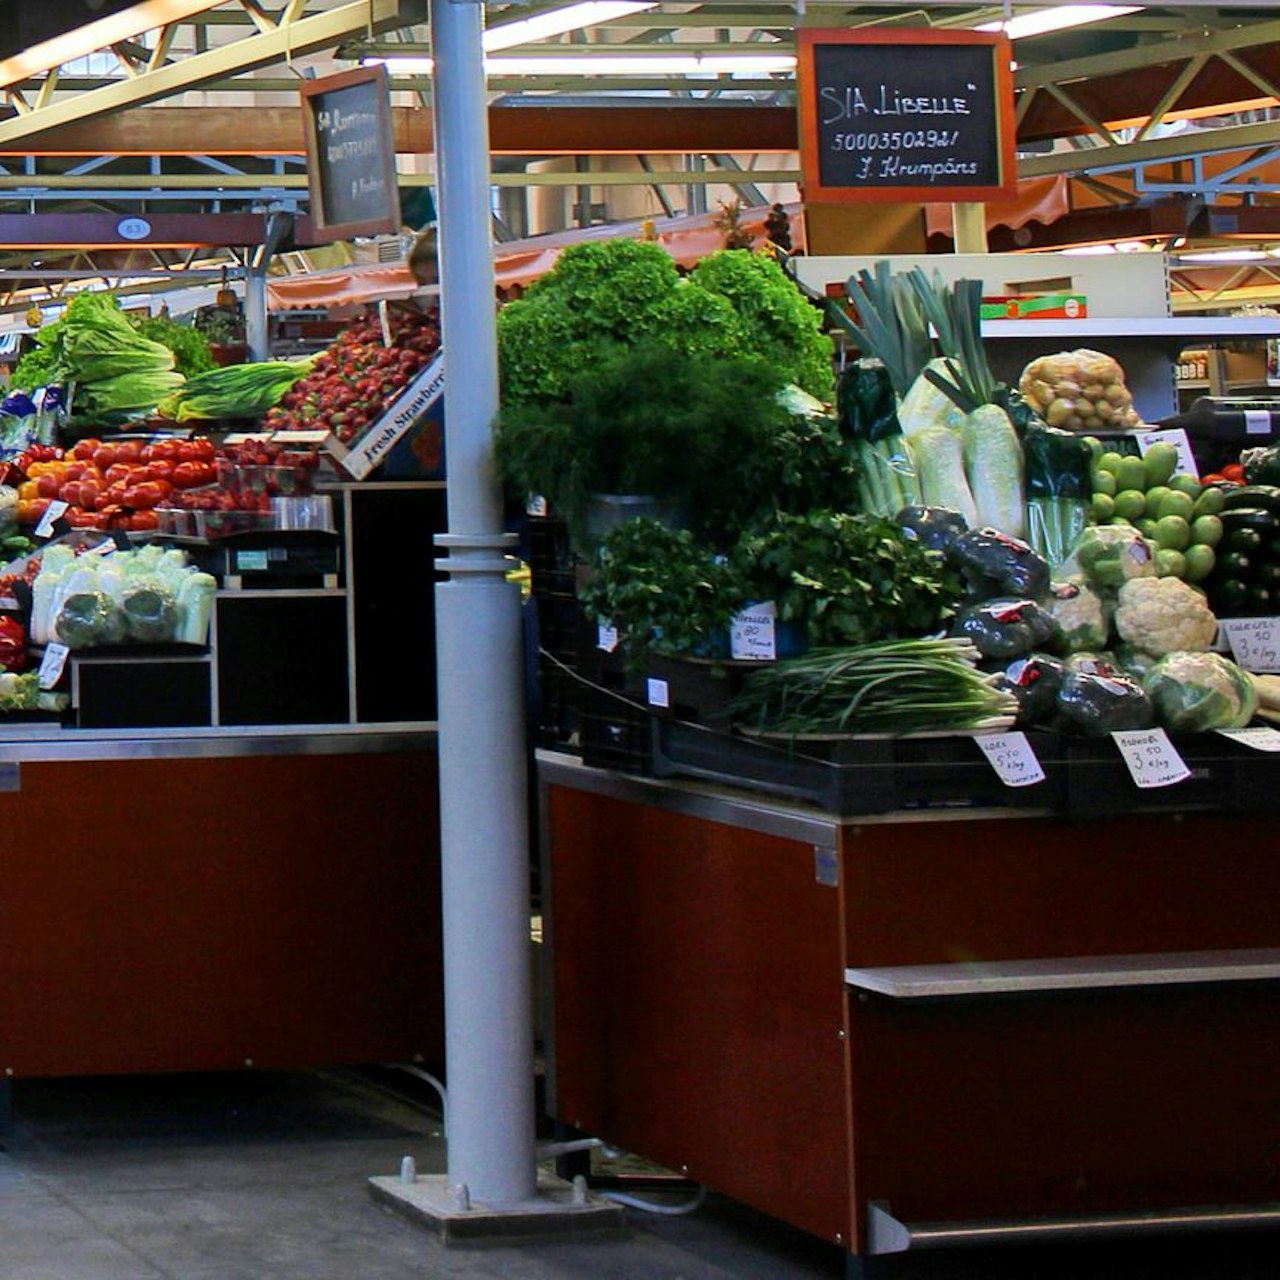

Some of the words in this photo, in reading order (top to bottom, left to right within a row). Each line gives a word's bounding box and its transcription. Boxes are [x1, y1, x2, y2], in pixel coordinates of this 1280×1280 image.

[820, 86, 869, 124] SIA
[363, 426, 396, 461] Fresh
[394, 368, 444, 429] Strawberr
[1132, 751, 1143, 770] 3
